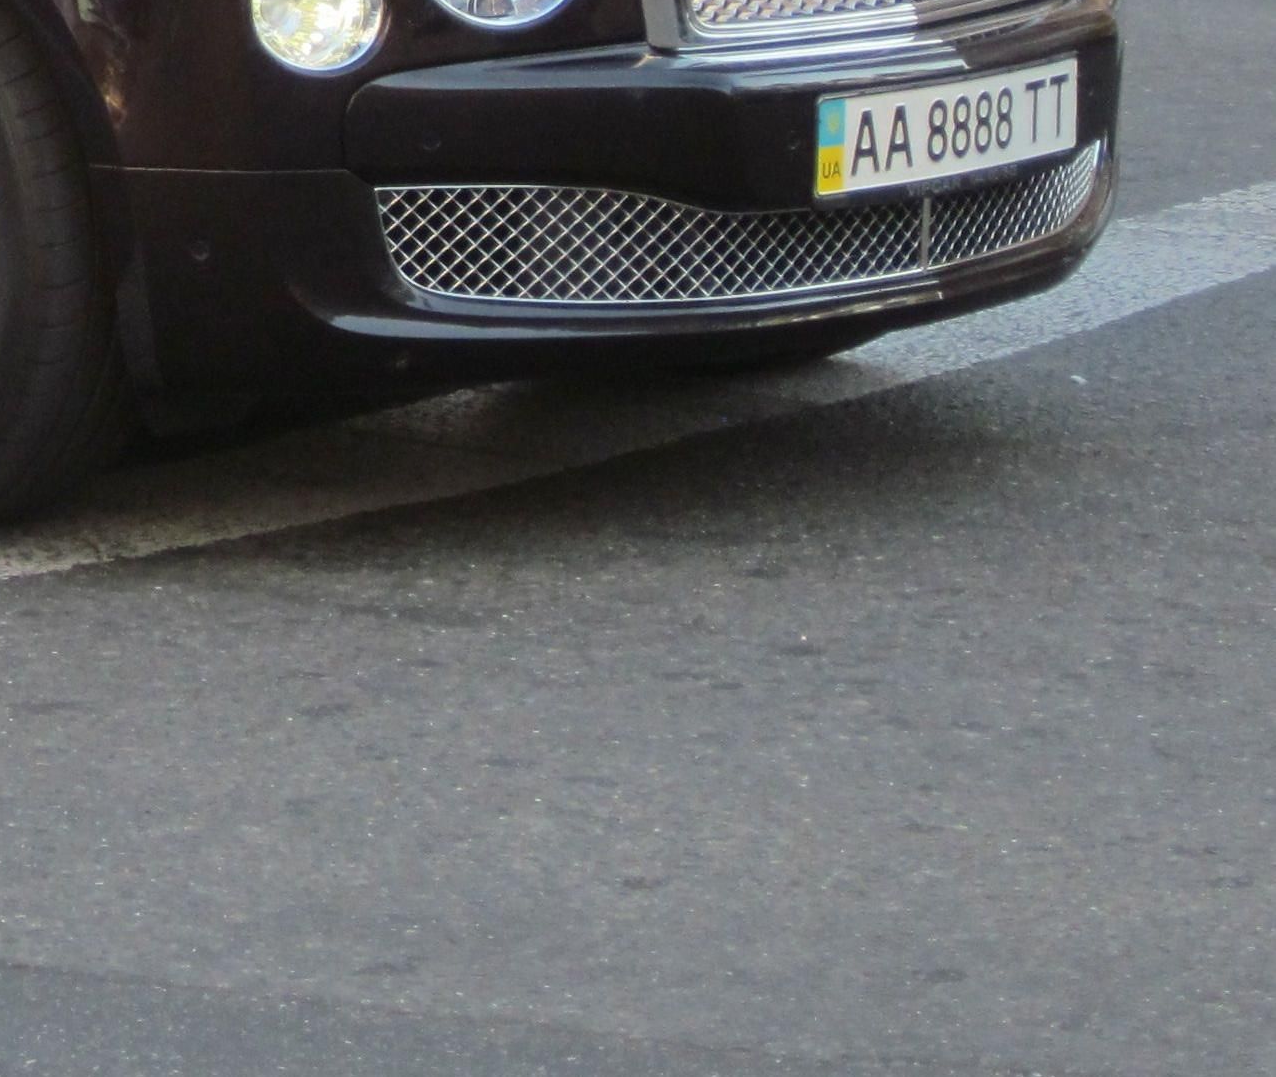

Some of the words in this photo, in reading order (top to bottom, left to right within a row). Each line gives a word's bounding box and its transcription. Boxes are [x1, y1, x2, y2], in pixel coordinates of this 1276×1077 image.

[851, 103, 913, 177] AA
[927, 86, 1013, 161] 8888
[1025, 74, 1069, 143] TT
[822, 161, 842, 179] UA
